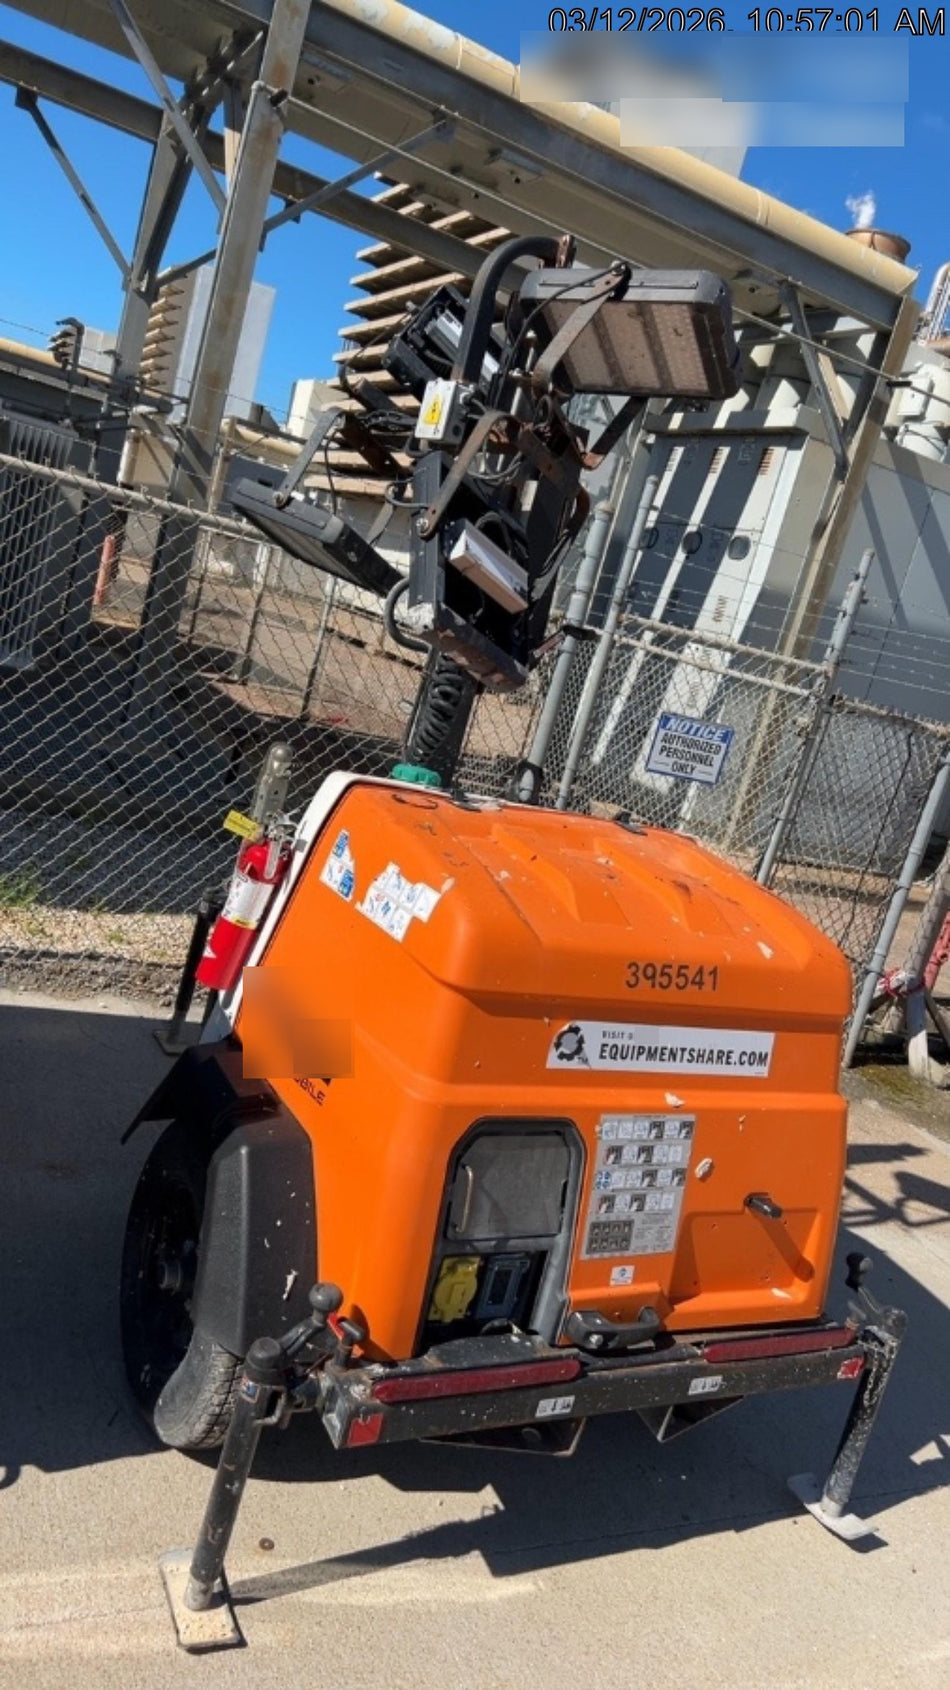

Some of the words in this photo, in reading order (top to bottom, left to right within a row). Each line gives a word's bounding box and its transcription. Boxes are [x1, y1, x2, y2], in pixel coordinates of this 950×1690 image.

[665, 717, 724, 742] NOTICE
[661, 732, 722, 755] AUTHORIZED
[658, 745, 714, 767] PERSONNEL
[671, 761, 697, 775] ONLY
[626, 962, 719, 991] 395541
[598, 1043, 769, 1067] EQUIPMENTSHARE.COM
